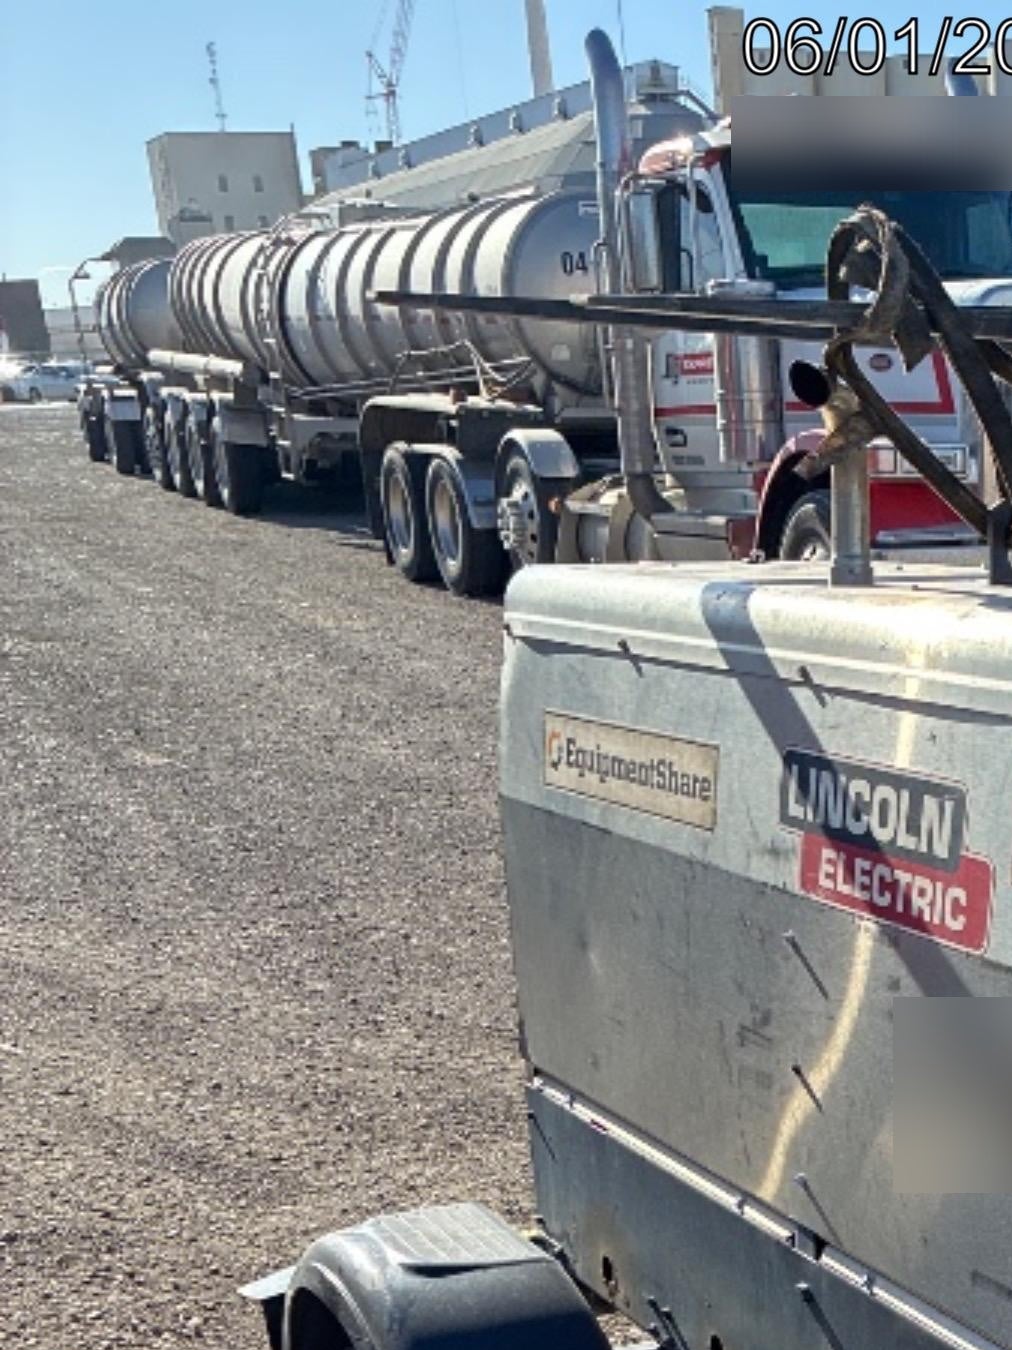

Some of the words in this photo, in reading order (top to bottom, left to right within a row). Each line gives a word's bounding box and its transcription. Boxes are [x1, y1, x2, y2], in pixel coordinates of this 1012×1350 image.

[566, 737, 712, 802] EquipmentShare
[787, 764, 955, 860] LINCOLN
[818, 848, 967, 931] ELECTRIC
